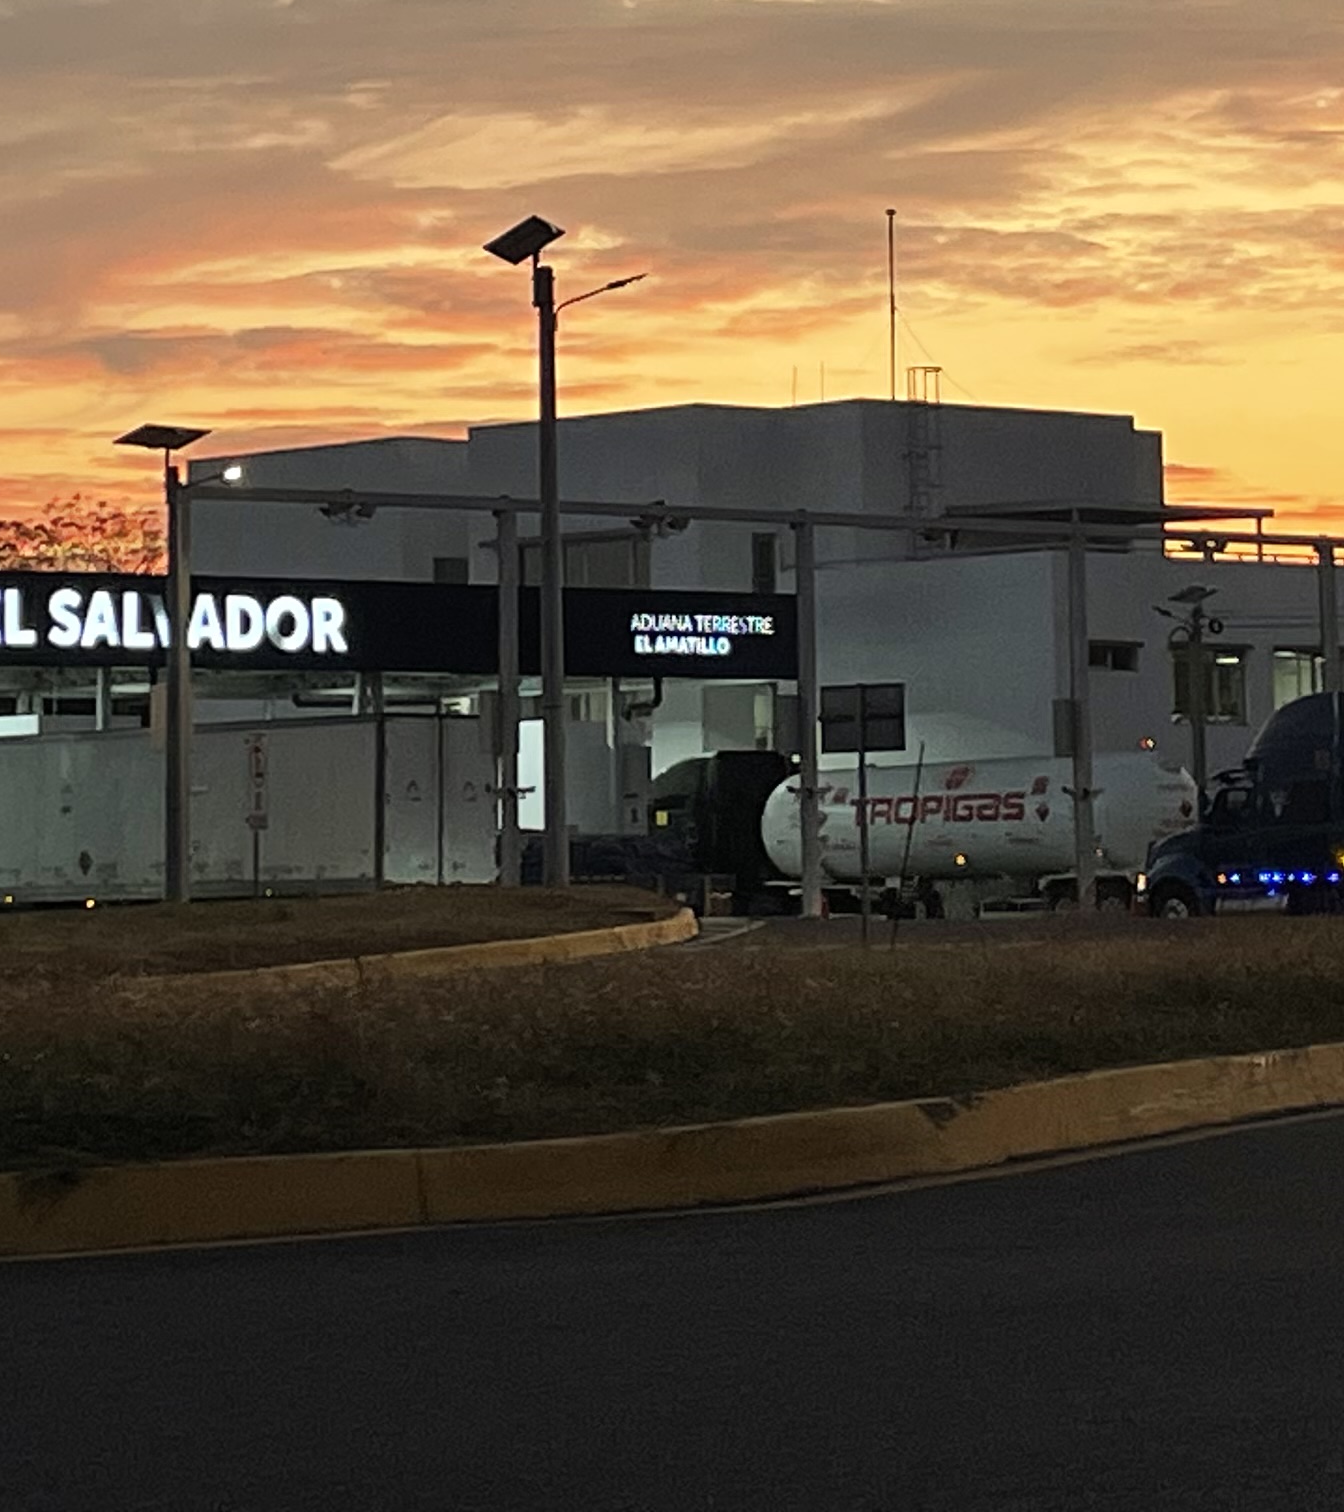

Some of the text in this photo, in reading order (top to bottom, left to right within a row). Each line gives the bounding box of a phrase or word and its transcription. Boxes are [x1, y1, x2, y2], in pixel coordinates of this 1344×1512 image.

[631, 613, 774, 635] ADUANA TERRESTRE
[635, 635, 730, 656] EL AMATILLO
